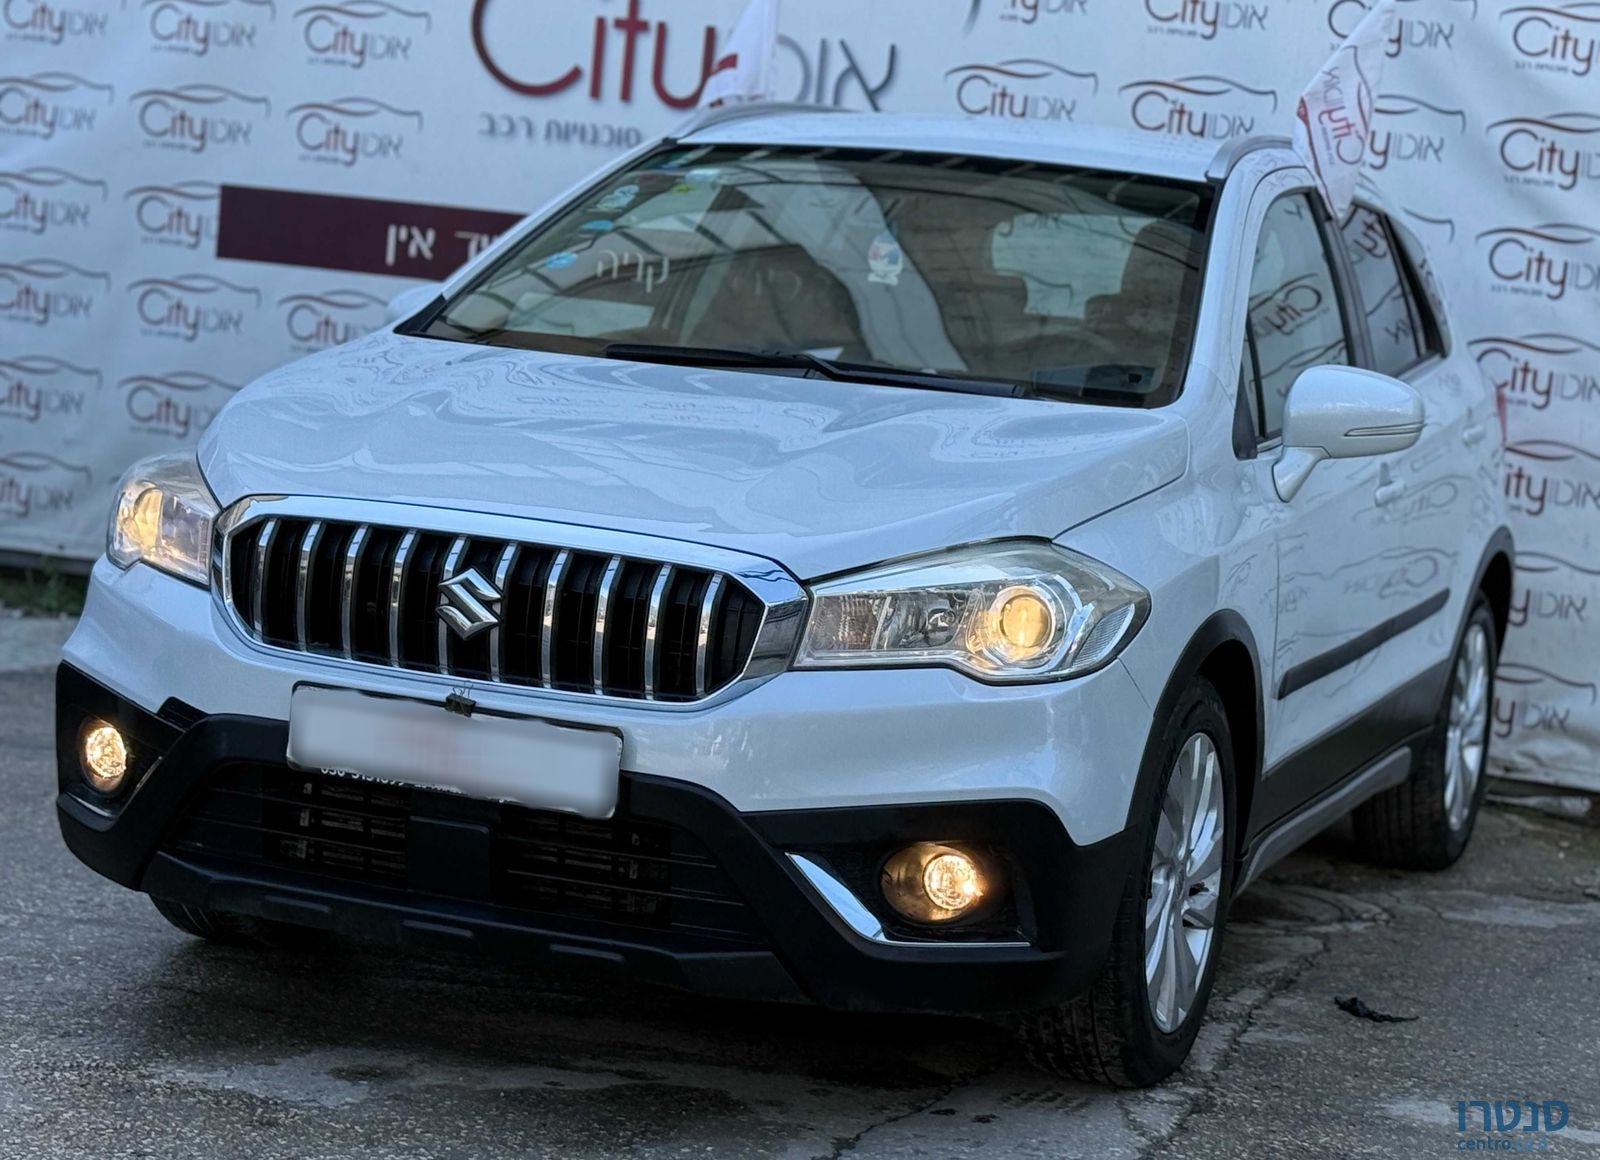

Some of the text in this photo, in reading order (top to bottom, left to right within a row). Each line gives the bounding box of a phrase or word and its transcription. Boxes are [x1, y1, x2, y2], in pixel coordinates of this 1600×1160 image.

[304, 14, 368, 69] City
[1328, 0, 1403, 58] Cy
[1513, 16, 1596, 77] City
[296, 112, 360, 168] City
[1500, 128, 1580, 191] City
[385, 224, 436, 267] אין
[1489, 237, 1568, 300] City
[1503, 463, 1547, 517] ity
